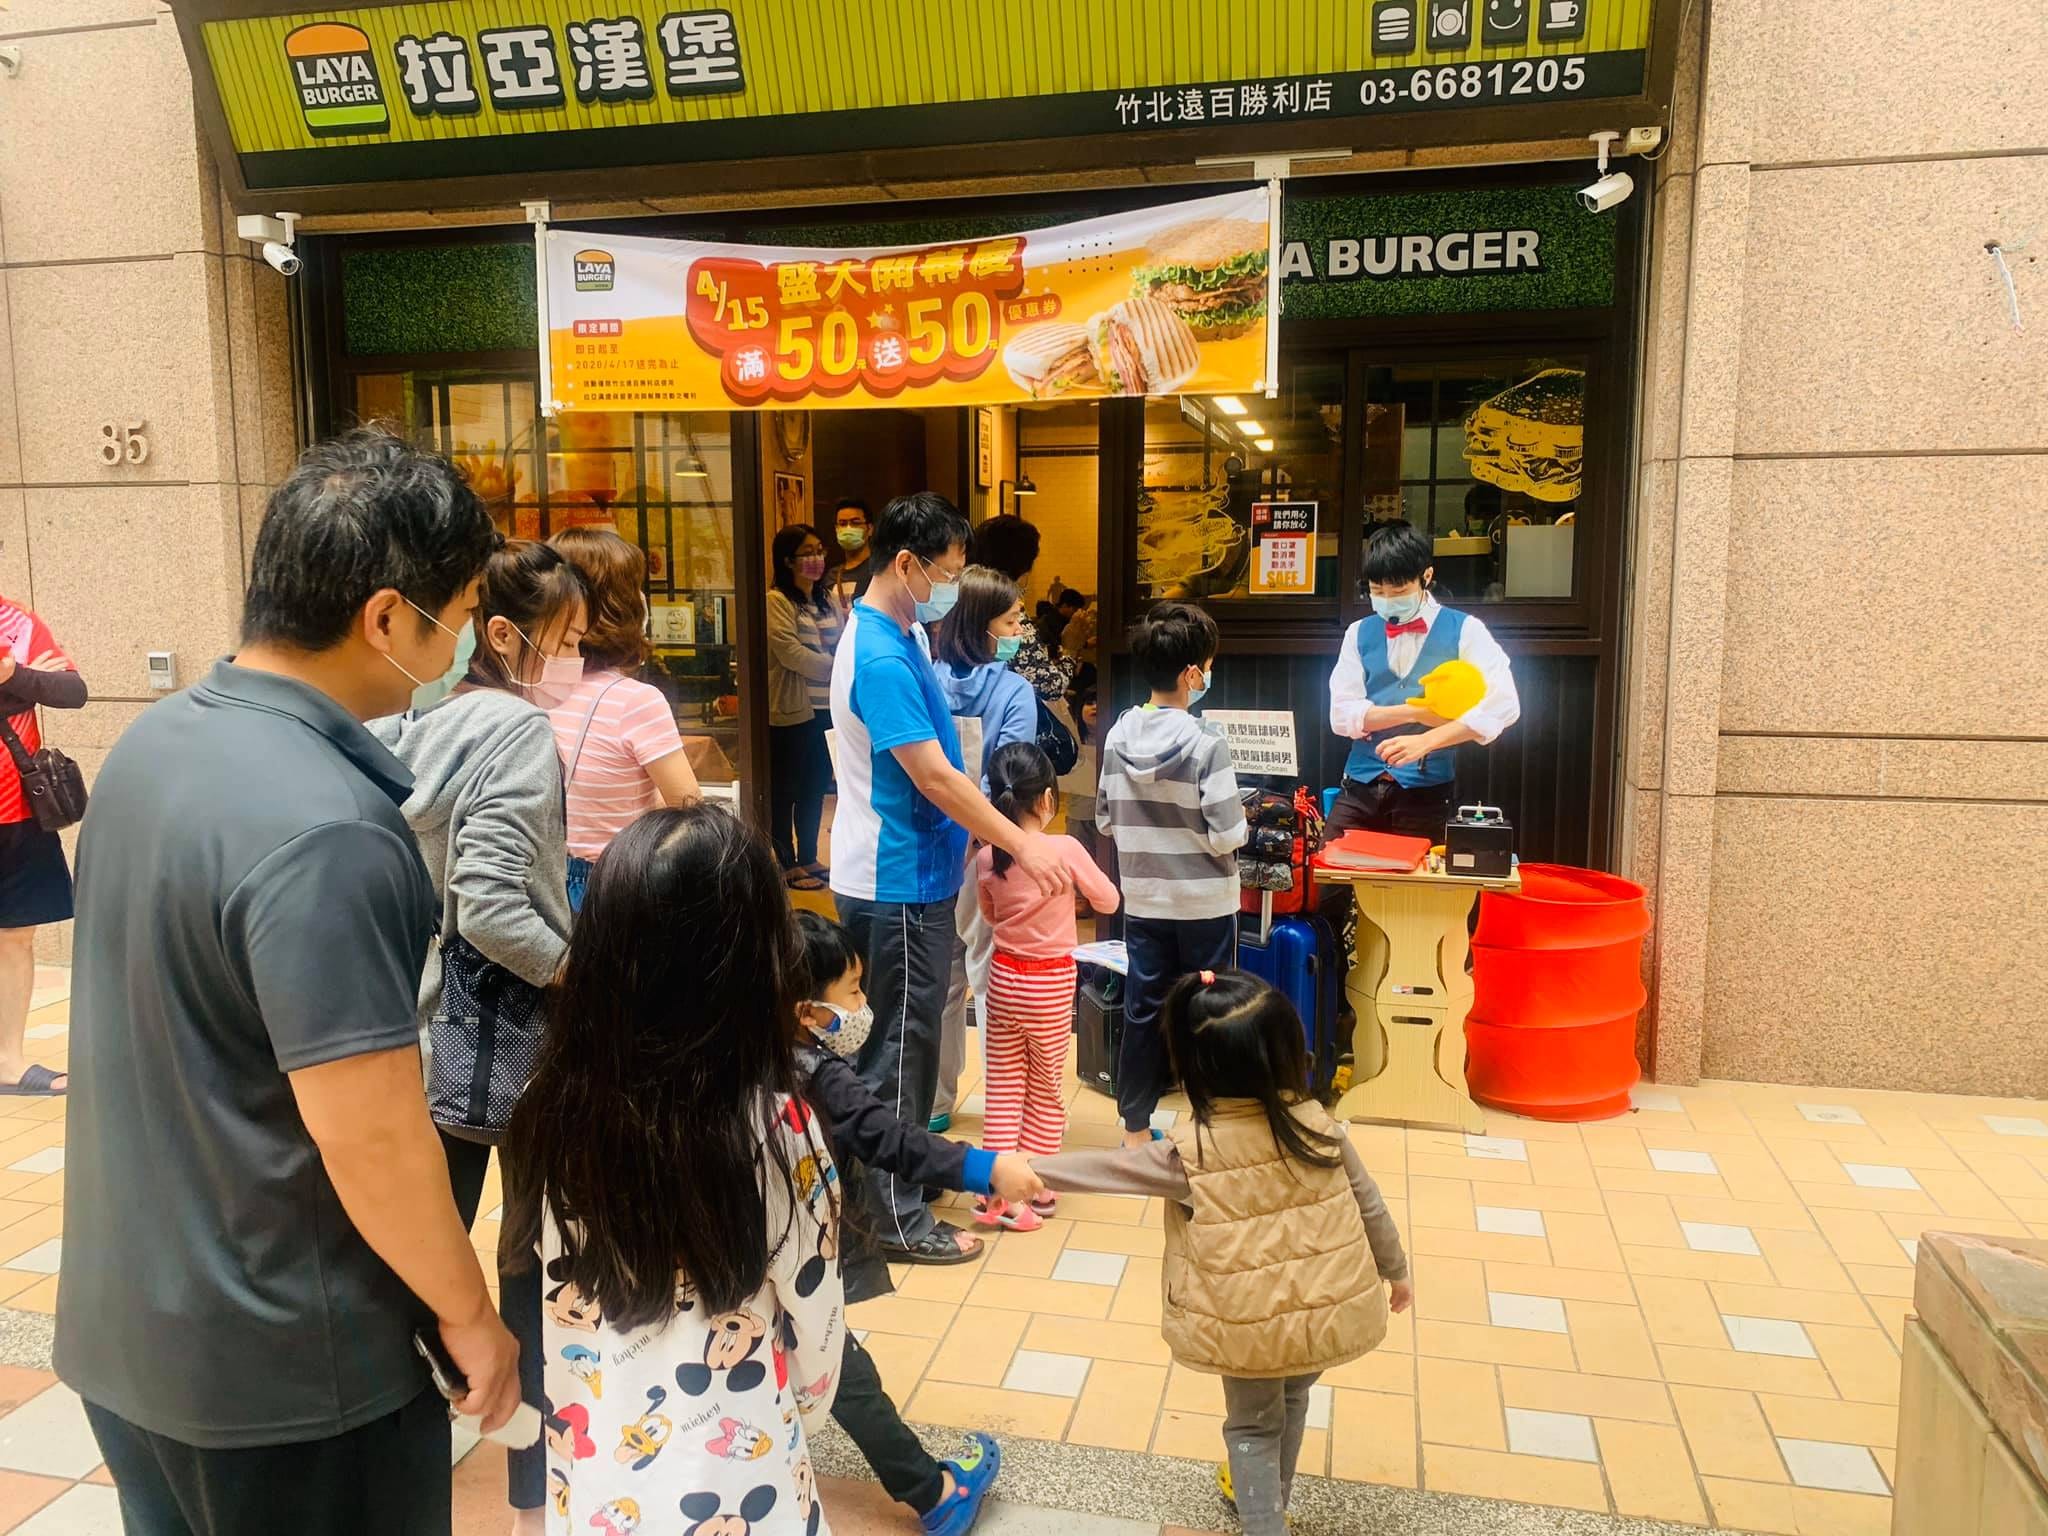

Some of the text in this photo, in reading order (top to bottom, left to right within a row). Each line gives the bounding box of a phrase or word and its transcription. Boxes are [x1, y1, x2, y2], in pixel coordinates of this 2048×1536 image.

[296, 55, 373, 86] LAYA
[398, 13, 741, 105] 拉亞漢堡
[302, 84, 379, 105] BURGER
[1360, 57, 1587, 106] 03-6681205
[1115, 80, 1334, 126] 竹北遠百勝利店
[577, 262, 612, 274] LAYA
[1328, 229, 1540, 277] BURGER
[577, 273, 611, 282] BURGER
[776, 238, 1020, 305] 盛大開幕慶
[695, 270, 769, 331] 4/15
[1008, 299, 1056, 321] 優惠券
[577, 322, 620, 335] 限定期間
[575, 343, 620, 355] 即日起至
[98, 419, 150, 467] 85
[1273, 510, 1308, 520] 我們用心
